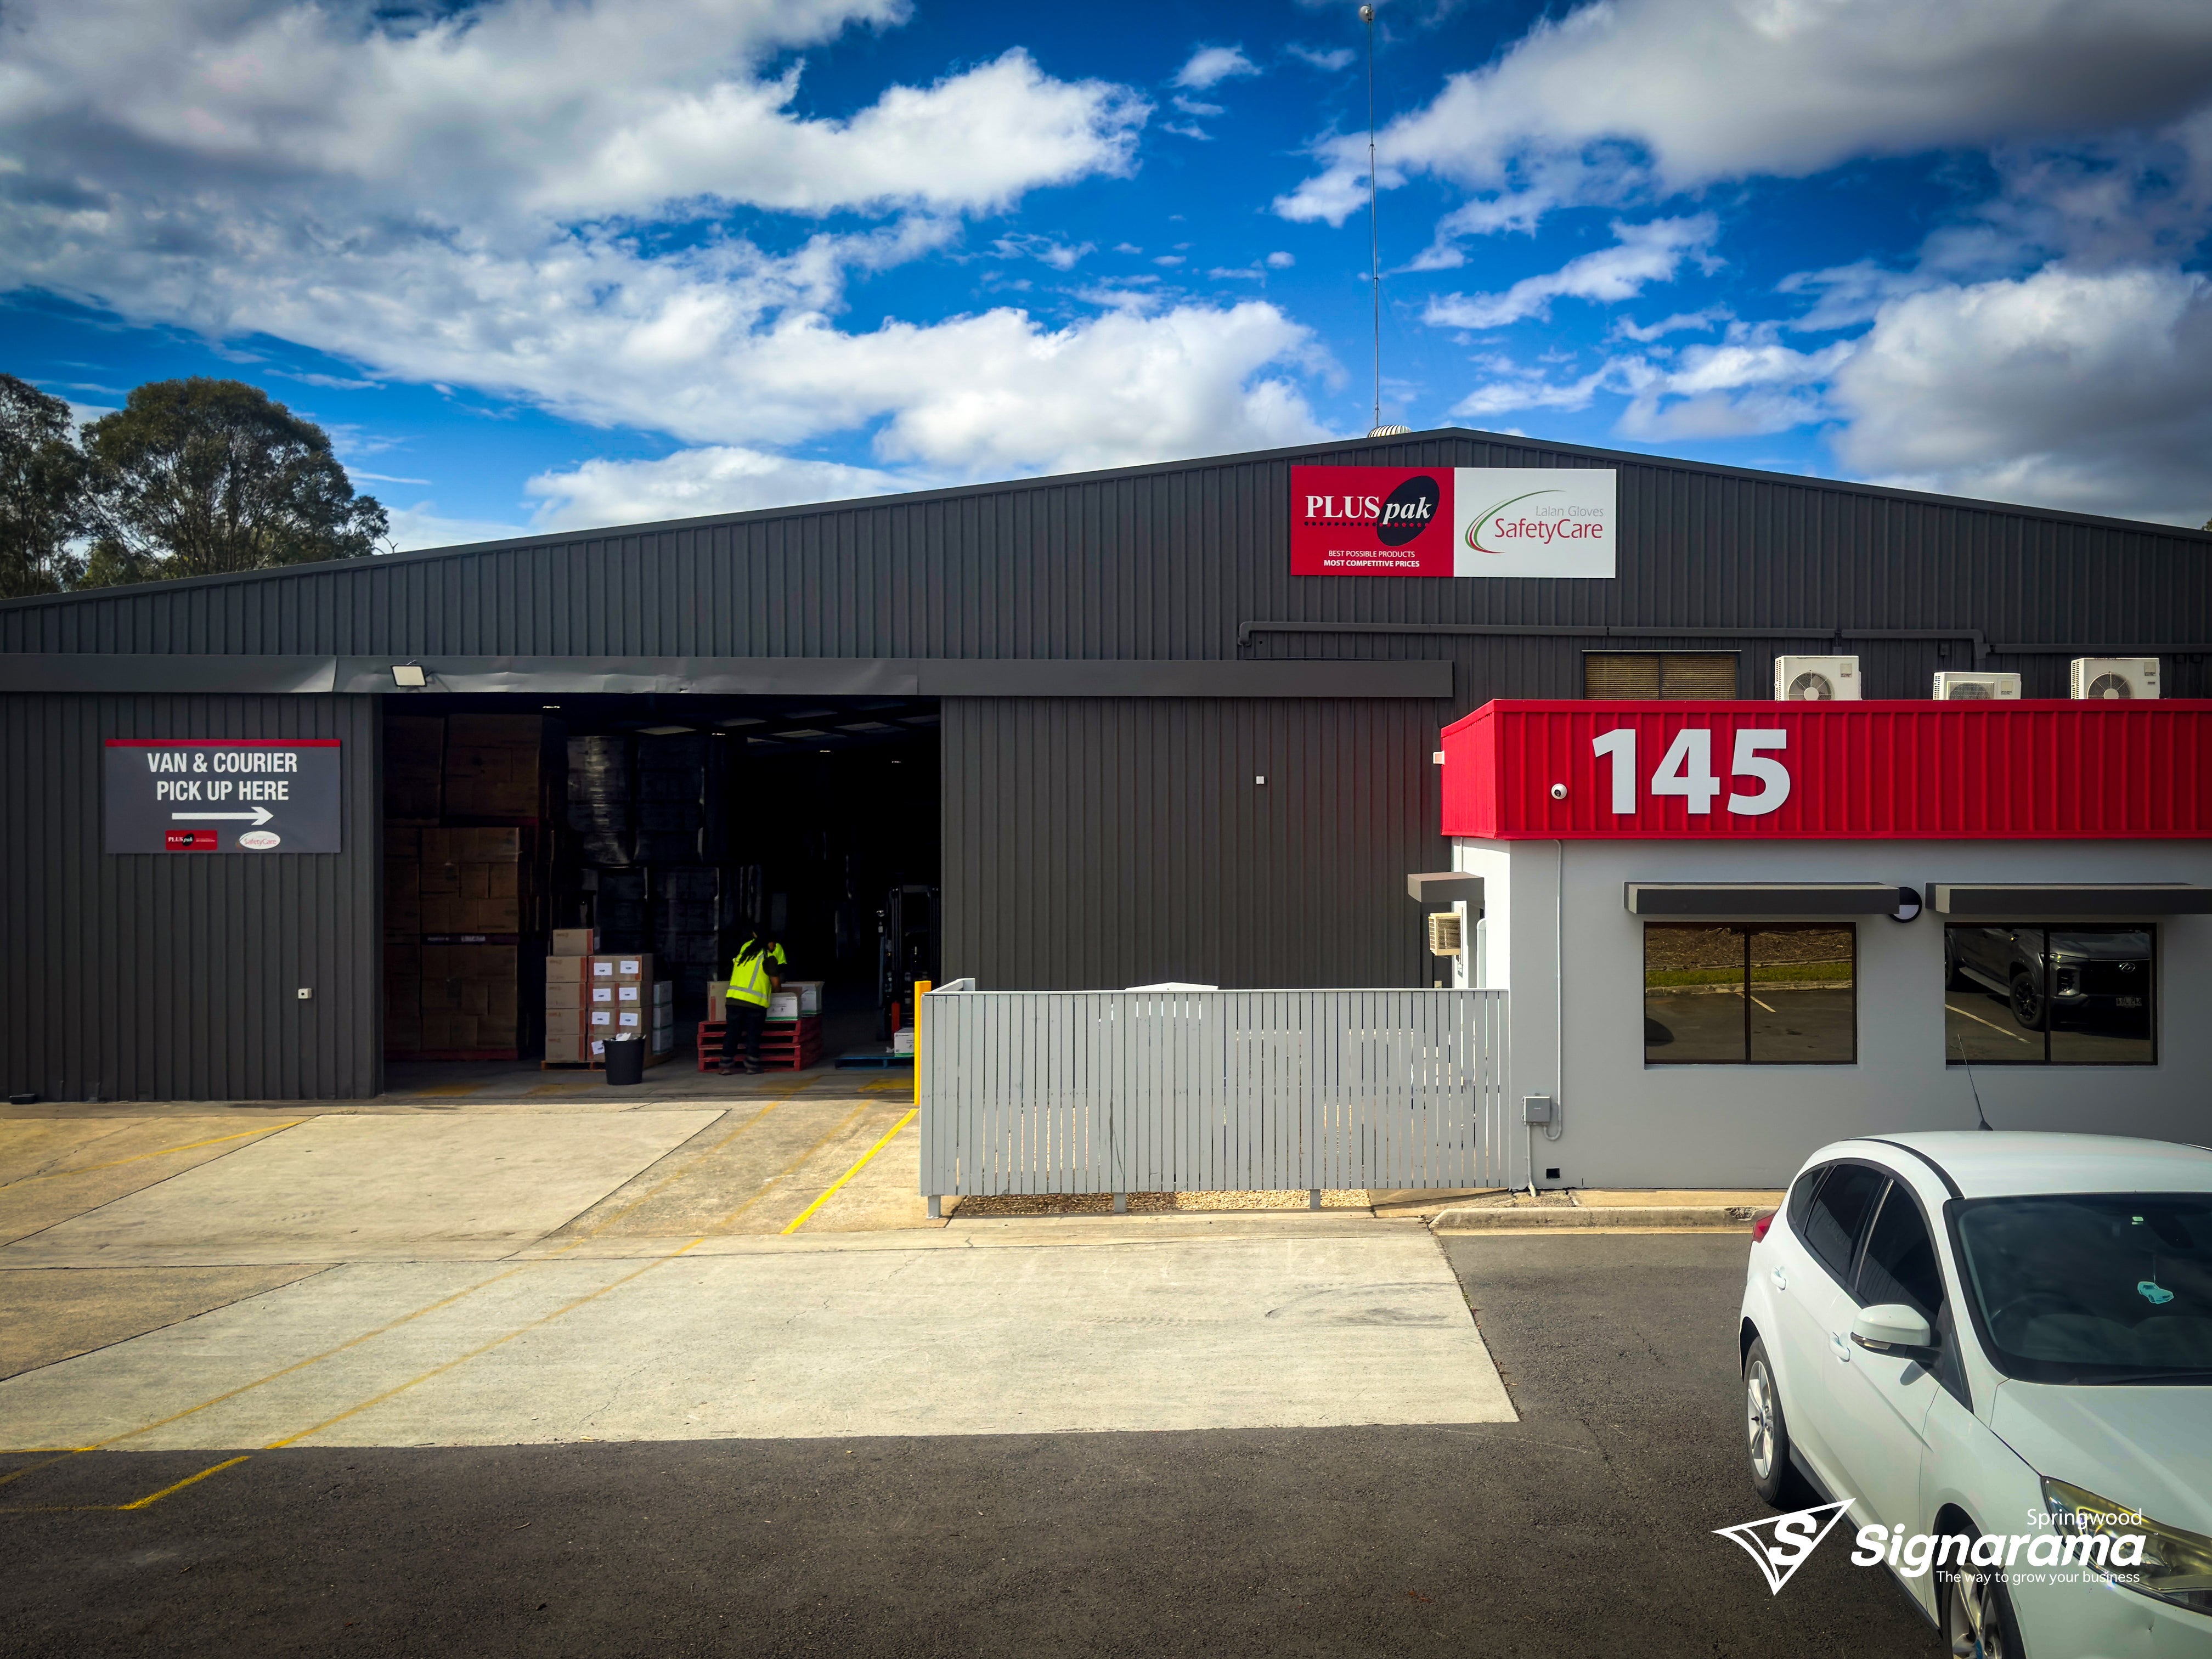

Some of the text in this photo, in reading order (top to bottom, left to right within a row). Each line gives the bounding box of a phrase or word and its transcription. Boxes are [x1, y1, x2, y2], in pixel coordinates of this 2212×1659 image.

[1536, 506, 1604, 517] Lalan Gloves
[1494, 518, 1603, 544] SafetyCare
[147, 753, 297, 773] VAN & COURIER
[1592, 729, 1791, 815] 145
[157, 781, 289, 800] PICK UP HERE
